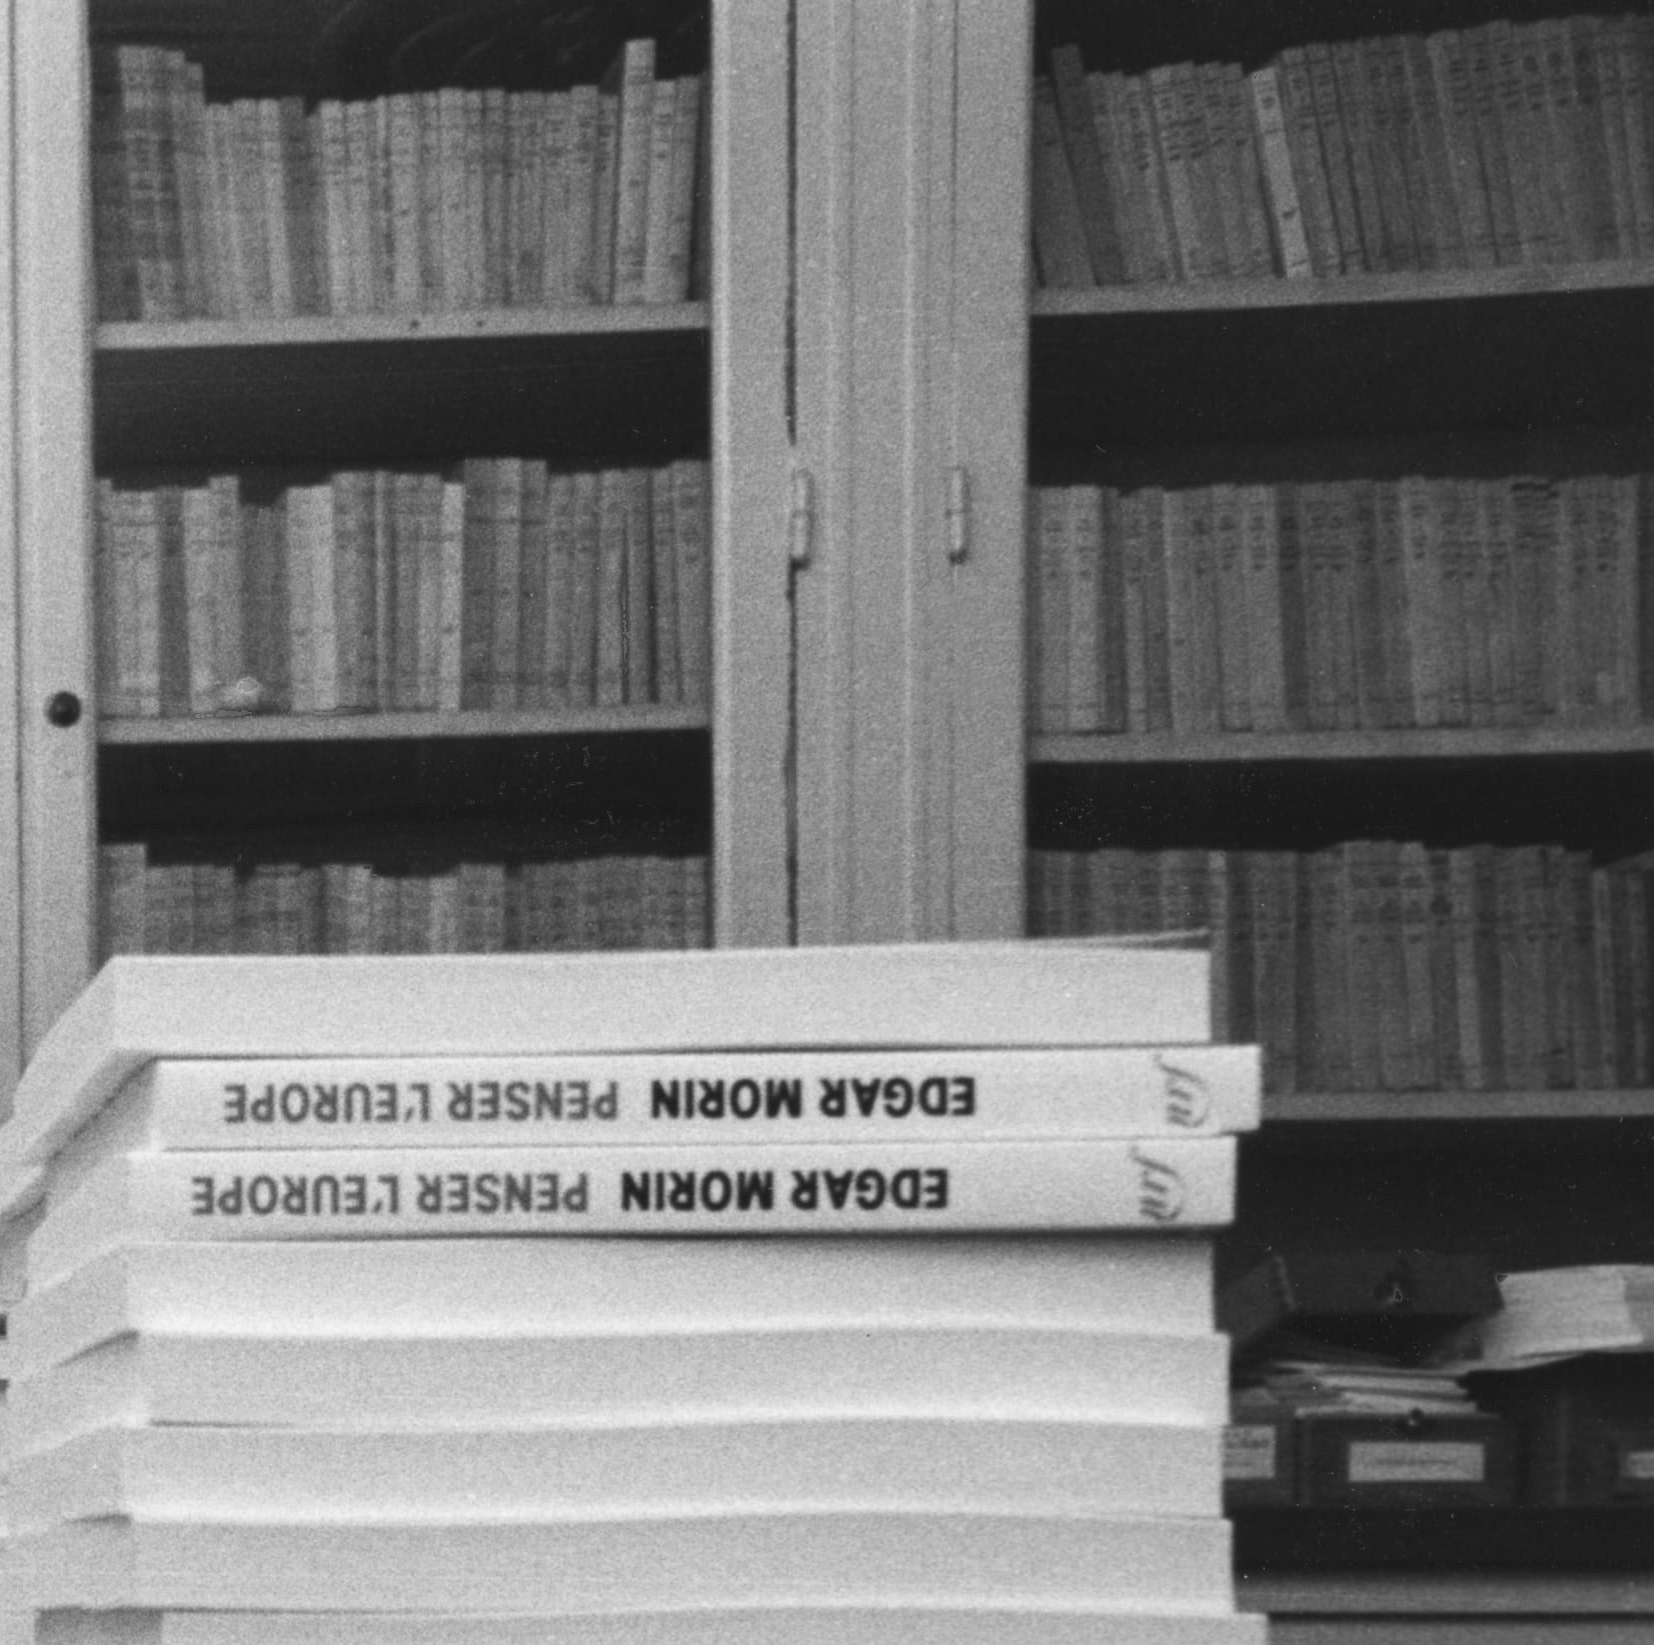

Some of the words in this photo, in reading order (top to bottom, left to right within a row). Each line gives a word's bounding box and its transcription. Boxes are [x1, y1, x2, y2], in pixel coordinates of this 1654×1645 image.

[222, 1081, 432, 1126] L'EUROPE
[445, 1079, 620, 1123] PENSER
[648, 1076, 806, 1122] MORIN
[816, 1074, 979, 1120] EDGAR
[190, 1172, 402, 1217] L'EUROPE
[415, 1171, 591, 1216] PENSER
[619, 1167, 777, 1214] MORIN
[788, 1166, 952, 1213] EDGAR
